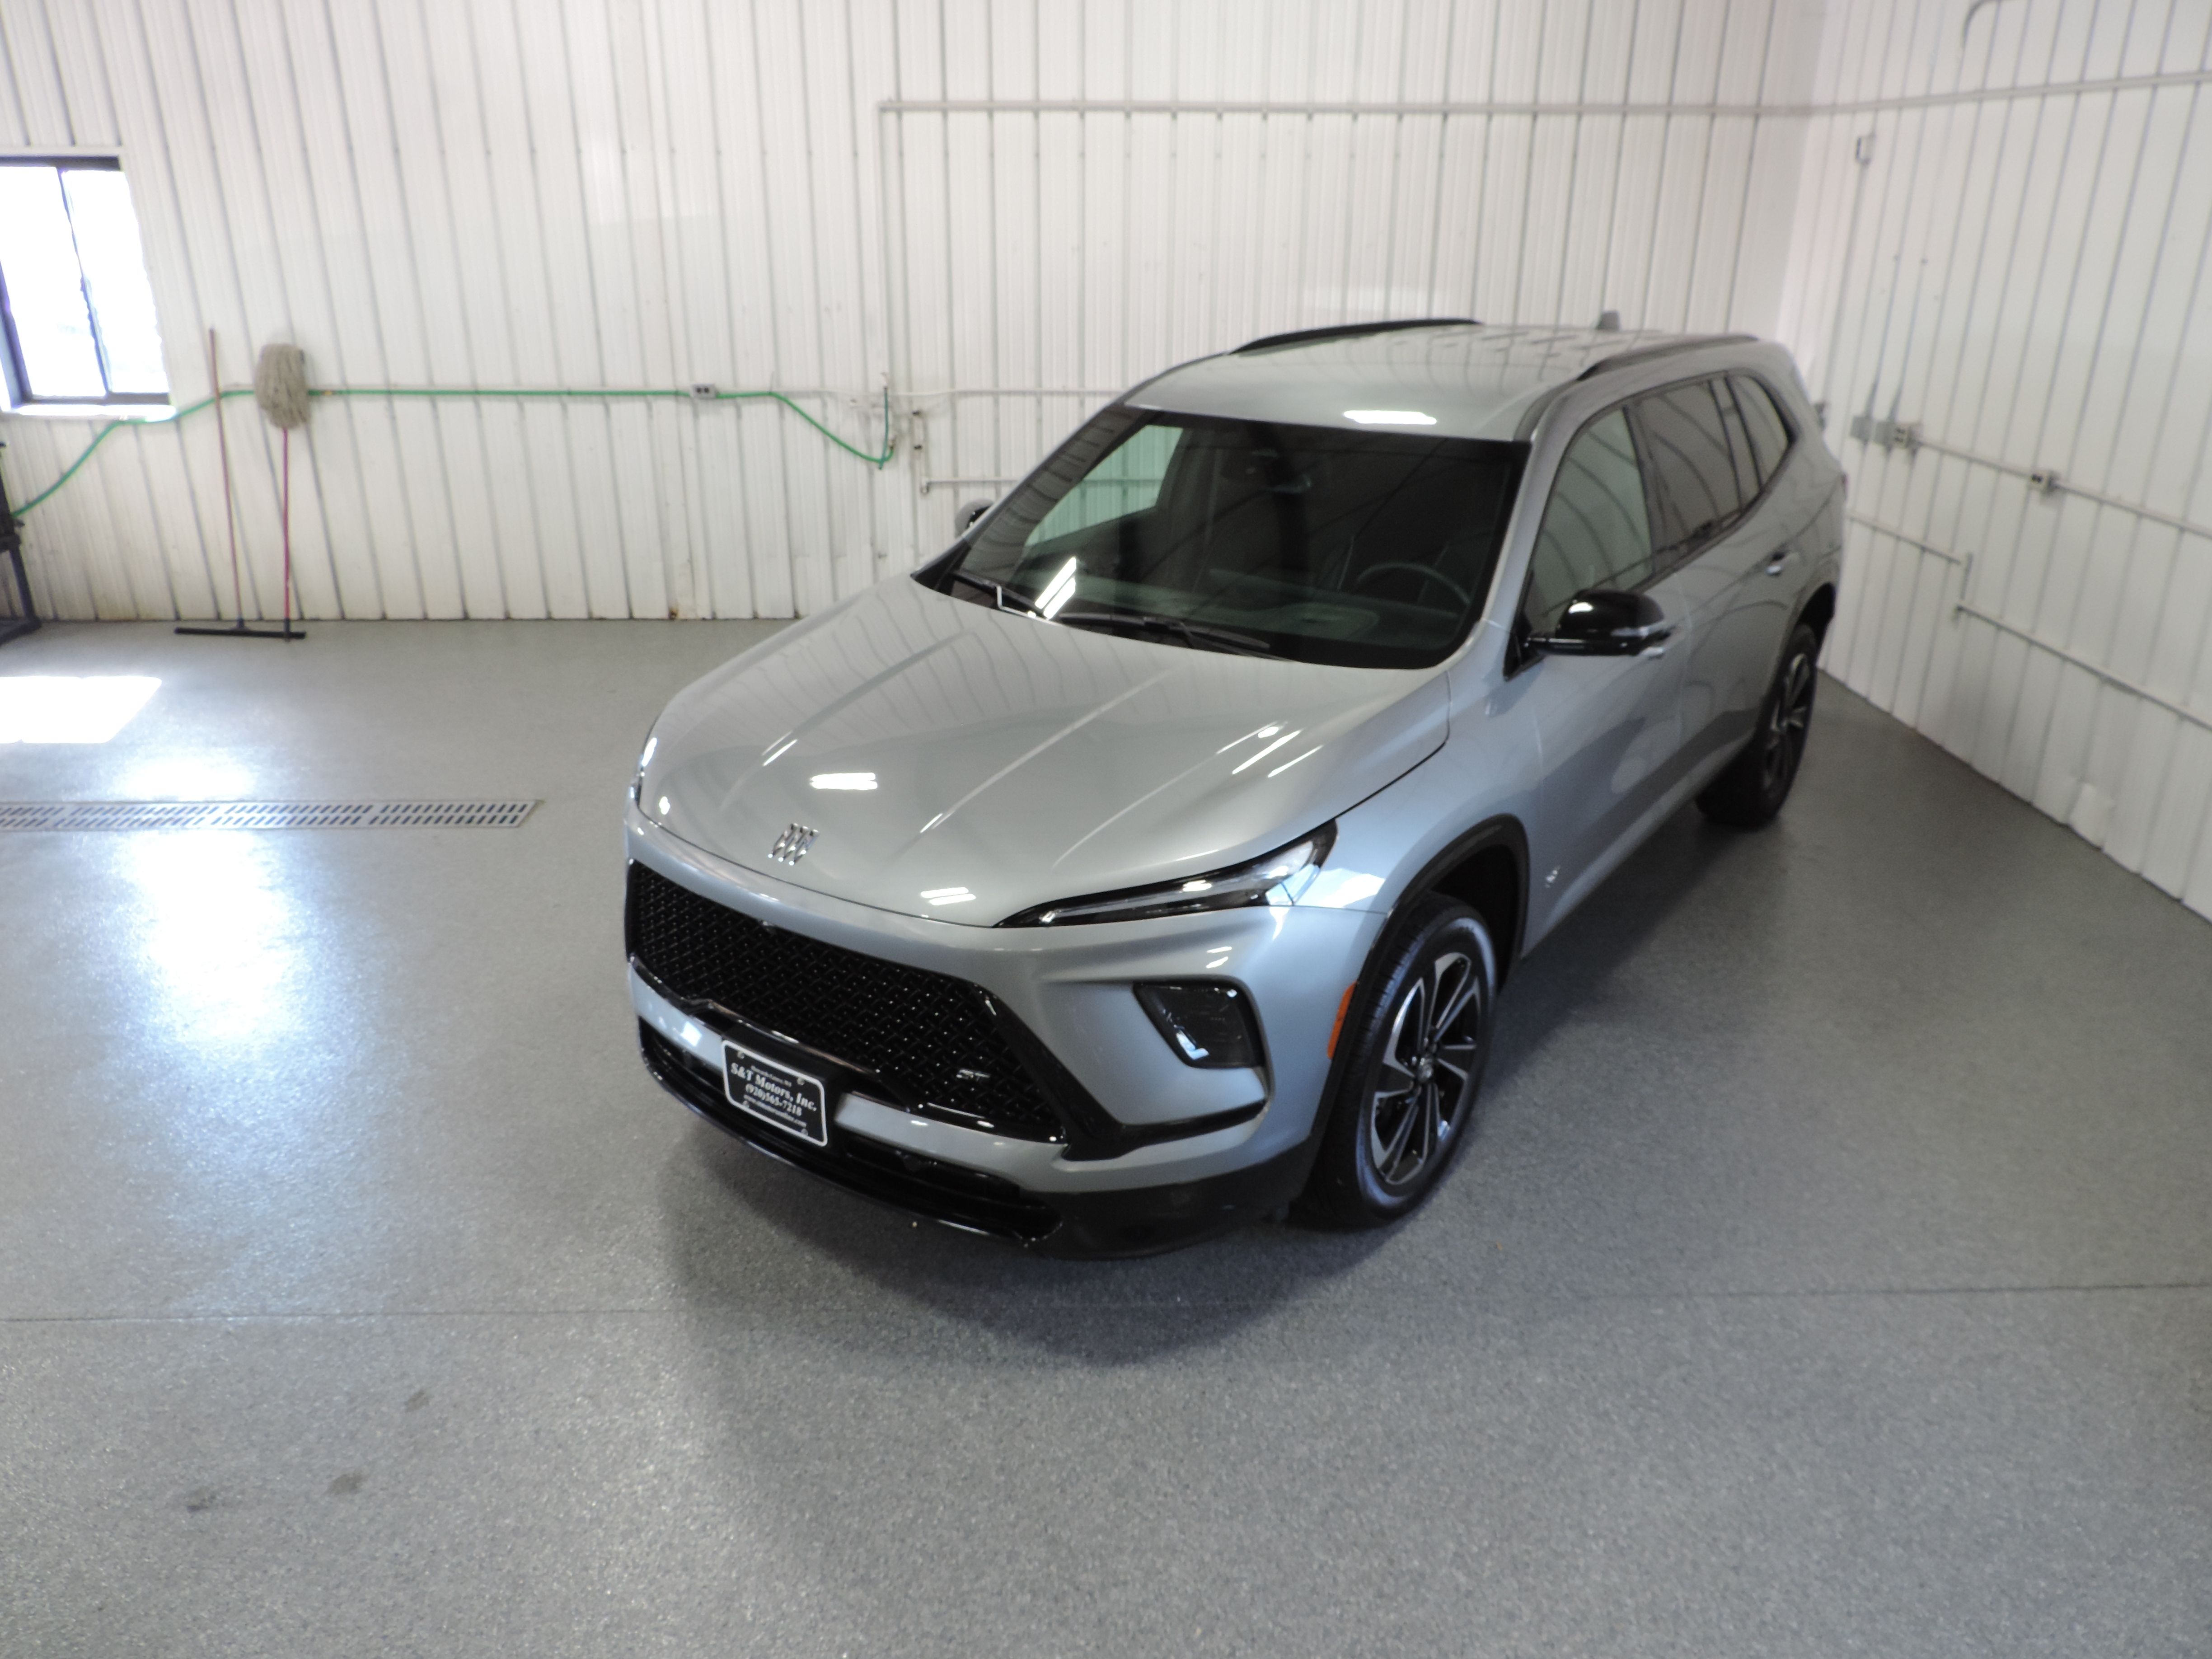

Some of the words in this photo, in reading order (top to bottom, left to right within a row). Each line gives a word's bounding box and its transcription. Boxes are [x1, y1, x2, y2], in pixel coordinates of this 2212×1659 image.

[731, 1063, 754, 1081] S&T
[755, 1074, 793, 1102] Motors,
[796, 1092, 817, 1111] Inc.
